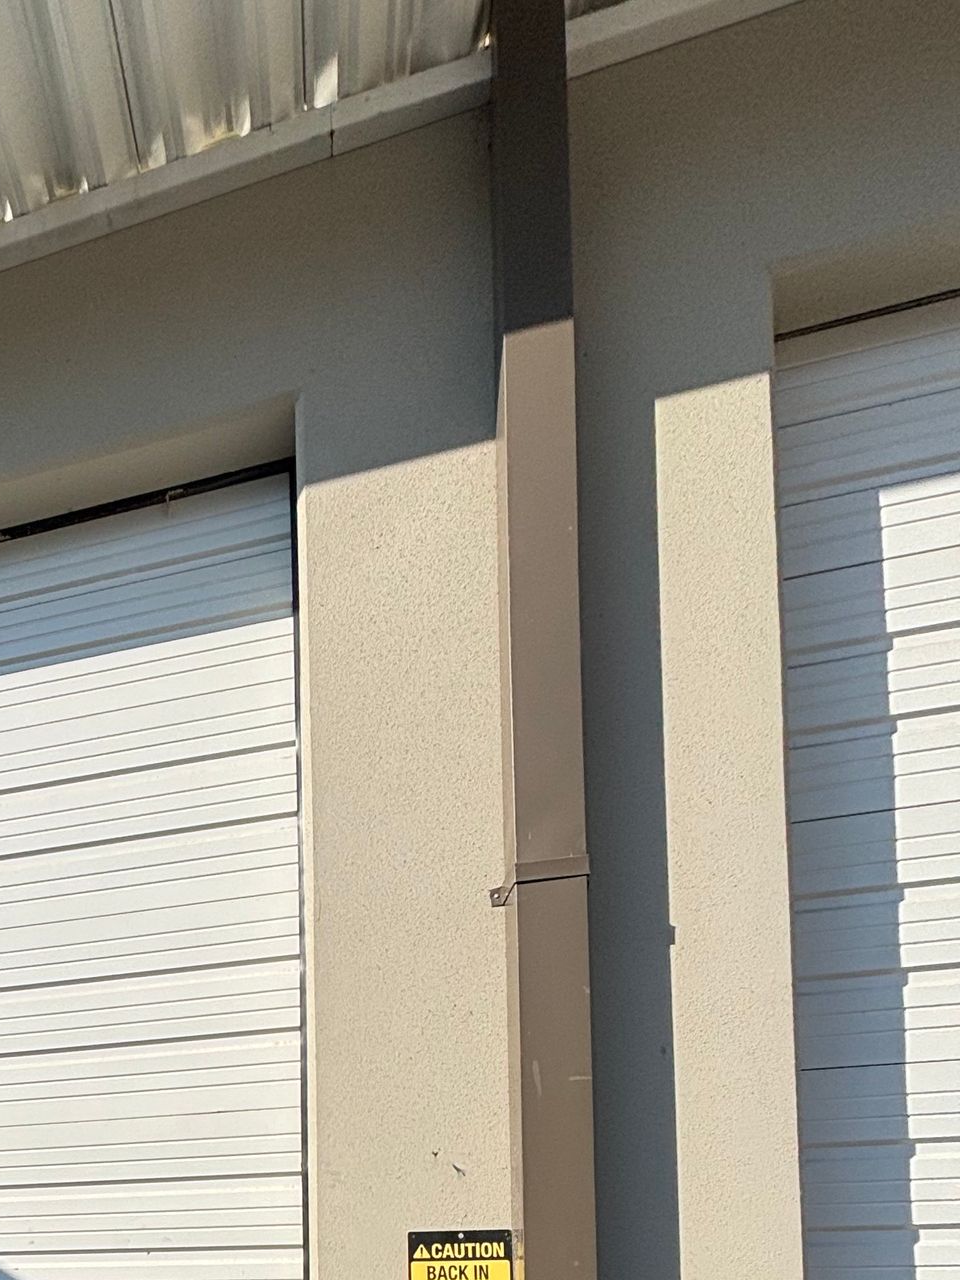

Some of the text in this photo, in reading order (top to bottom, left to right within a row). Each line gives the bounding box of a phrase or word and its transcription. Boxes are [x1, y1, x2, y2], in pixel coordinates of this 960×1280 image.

[431, 1242, 505, 1259] CAUTION
[426, 1265, 489, 1280] BACK IN
